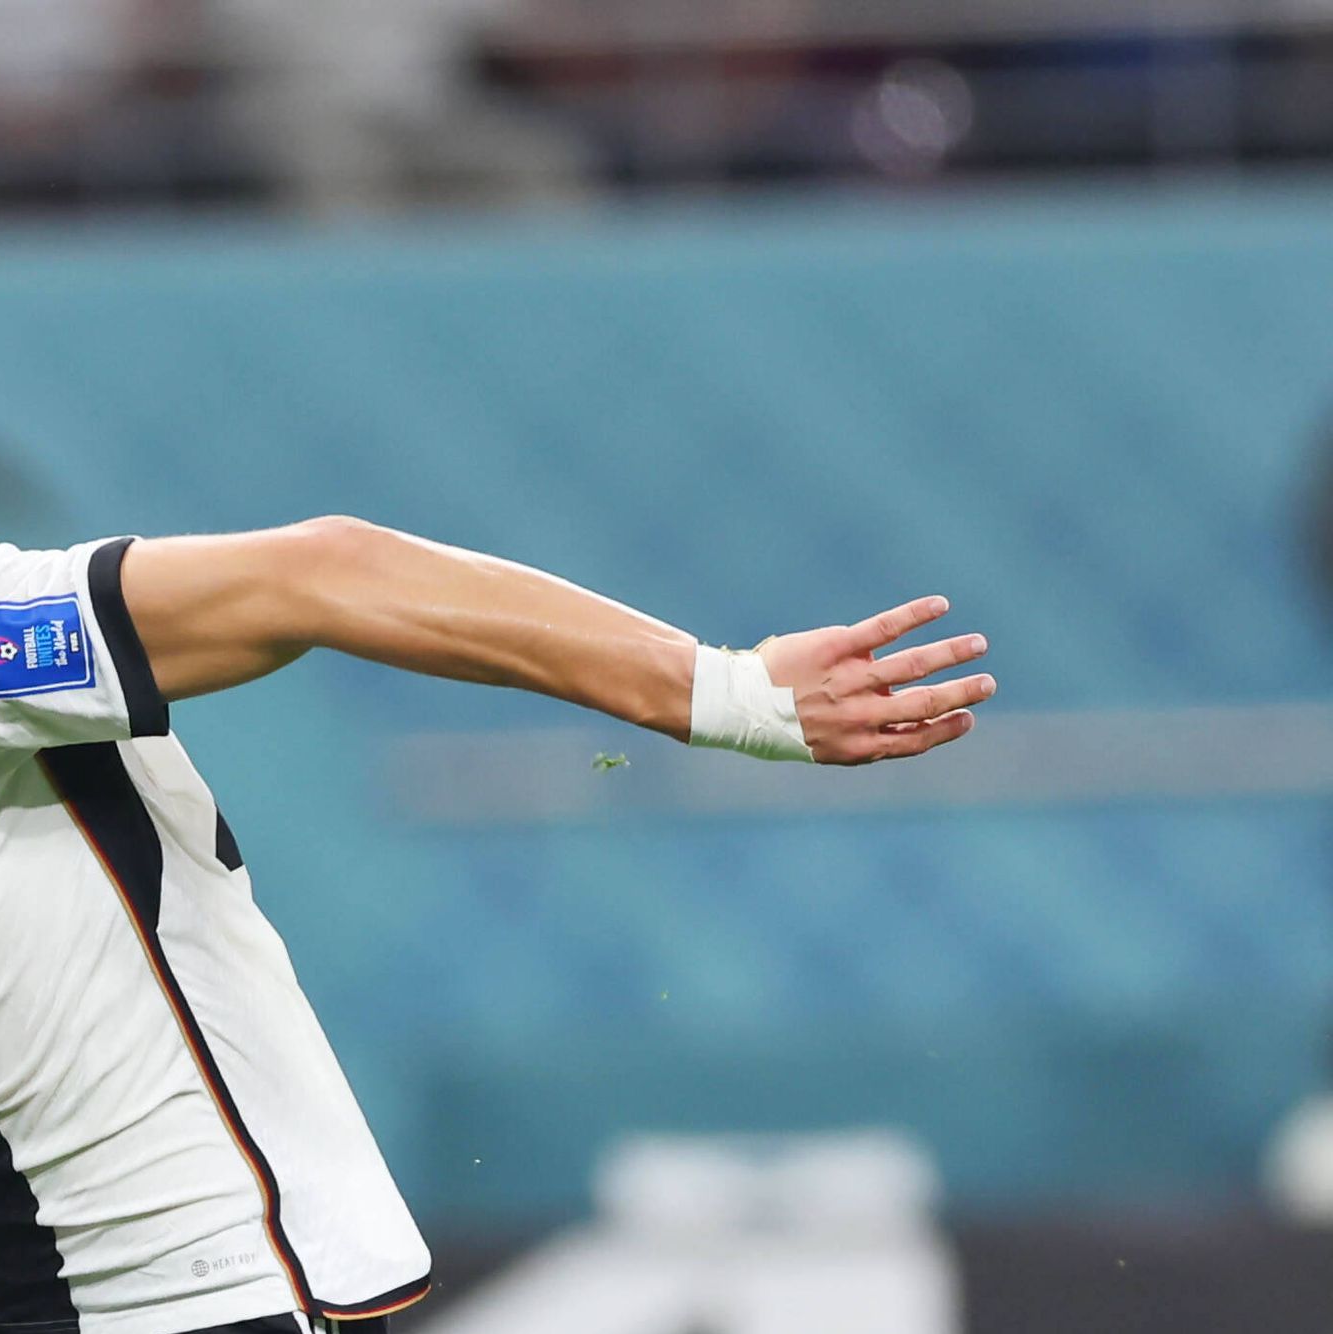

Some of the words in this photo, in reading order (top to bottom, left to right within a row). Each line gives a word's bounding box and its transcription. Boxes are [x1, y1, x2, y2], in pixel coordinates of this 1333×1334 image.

[23, 626, 38, 669] FOOTBALL
[36, 624, 54, 667] UNITES
[50, 620, 67, 651] World
[55, 650, 68, 667] the
